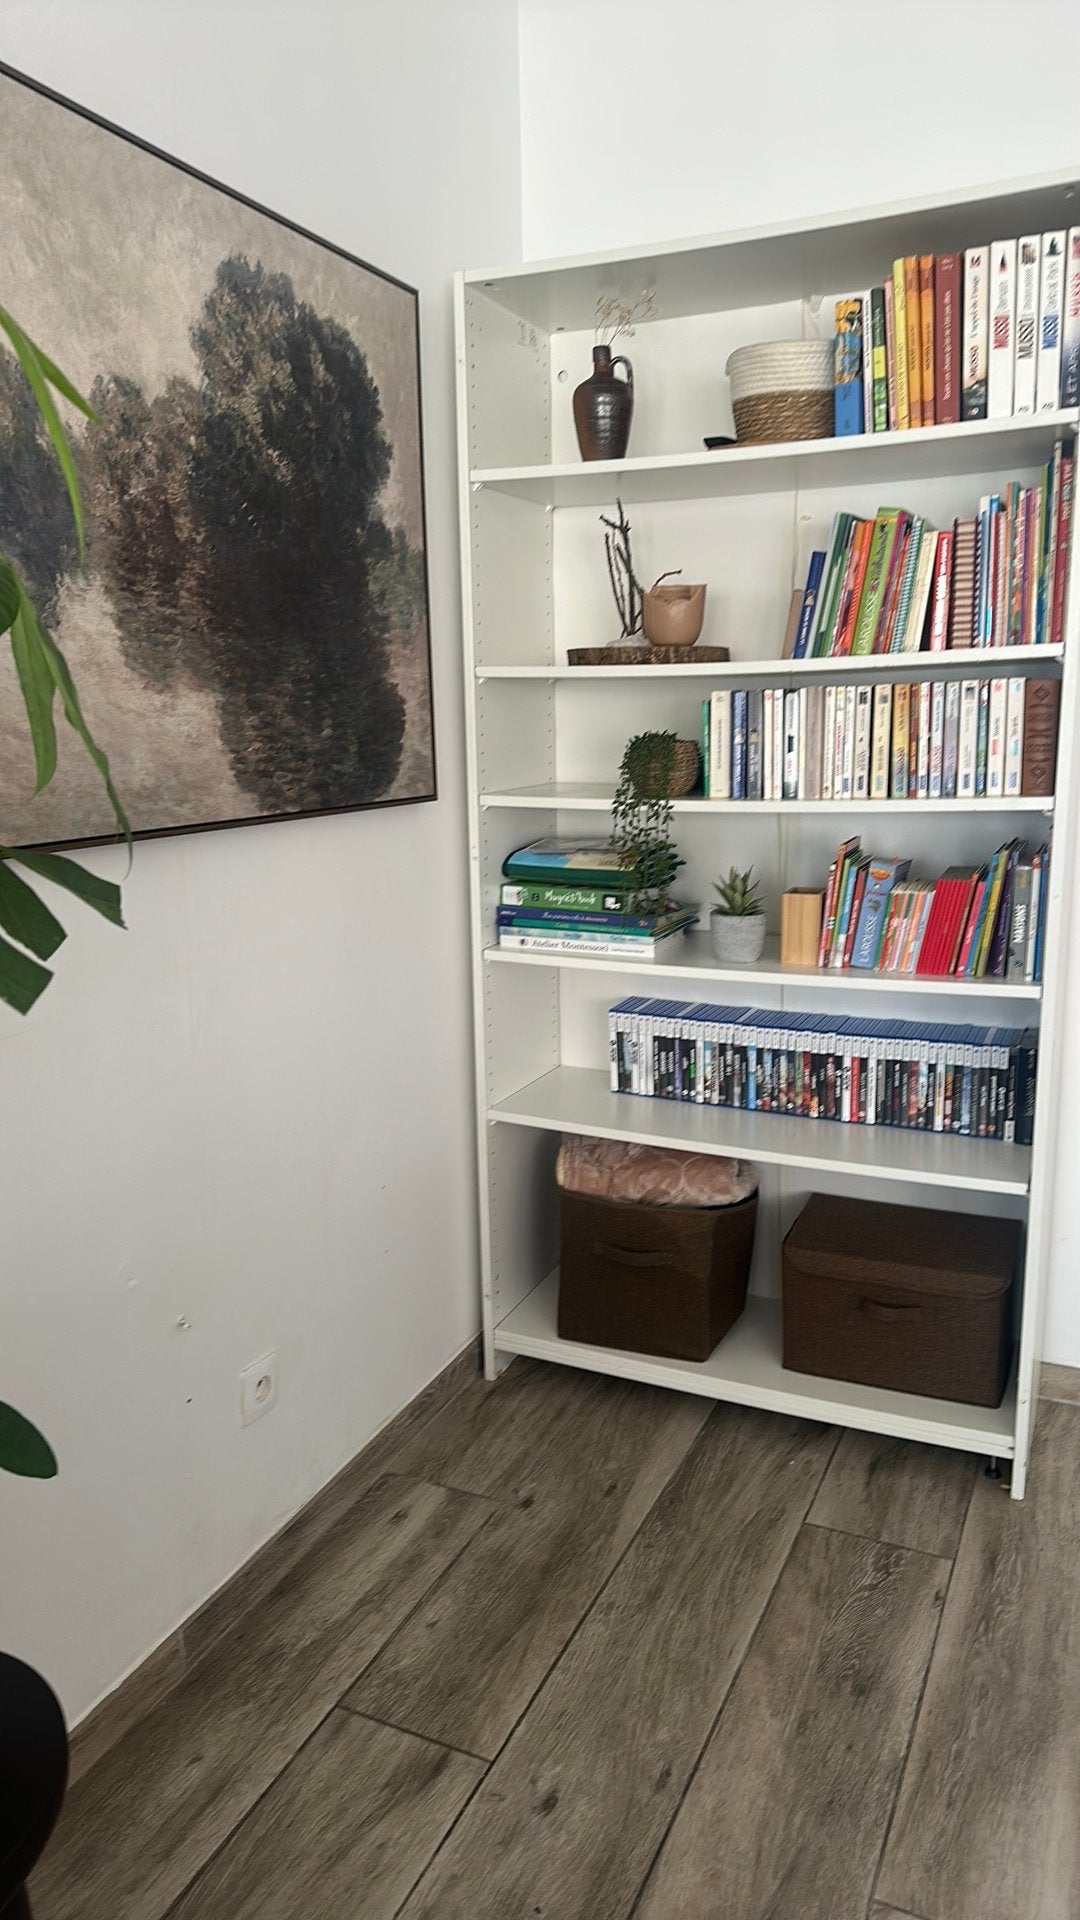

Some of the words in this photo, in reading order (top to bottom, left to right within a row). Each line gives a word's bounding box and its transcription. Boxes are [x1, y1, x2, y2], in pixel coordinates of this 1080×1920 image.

[992, 314, 1010, 351] MUSSO
[1041, 314, 1059, 351] MUSSO
[856, 591, 878, 655] LAROUSSE
[857, 914, 878, 963] LAROUSSE
[1012, 903, 1026, 944] MAISONS
